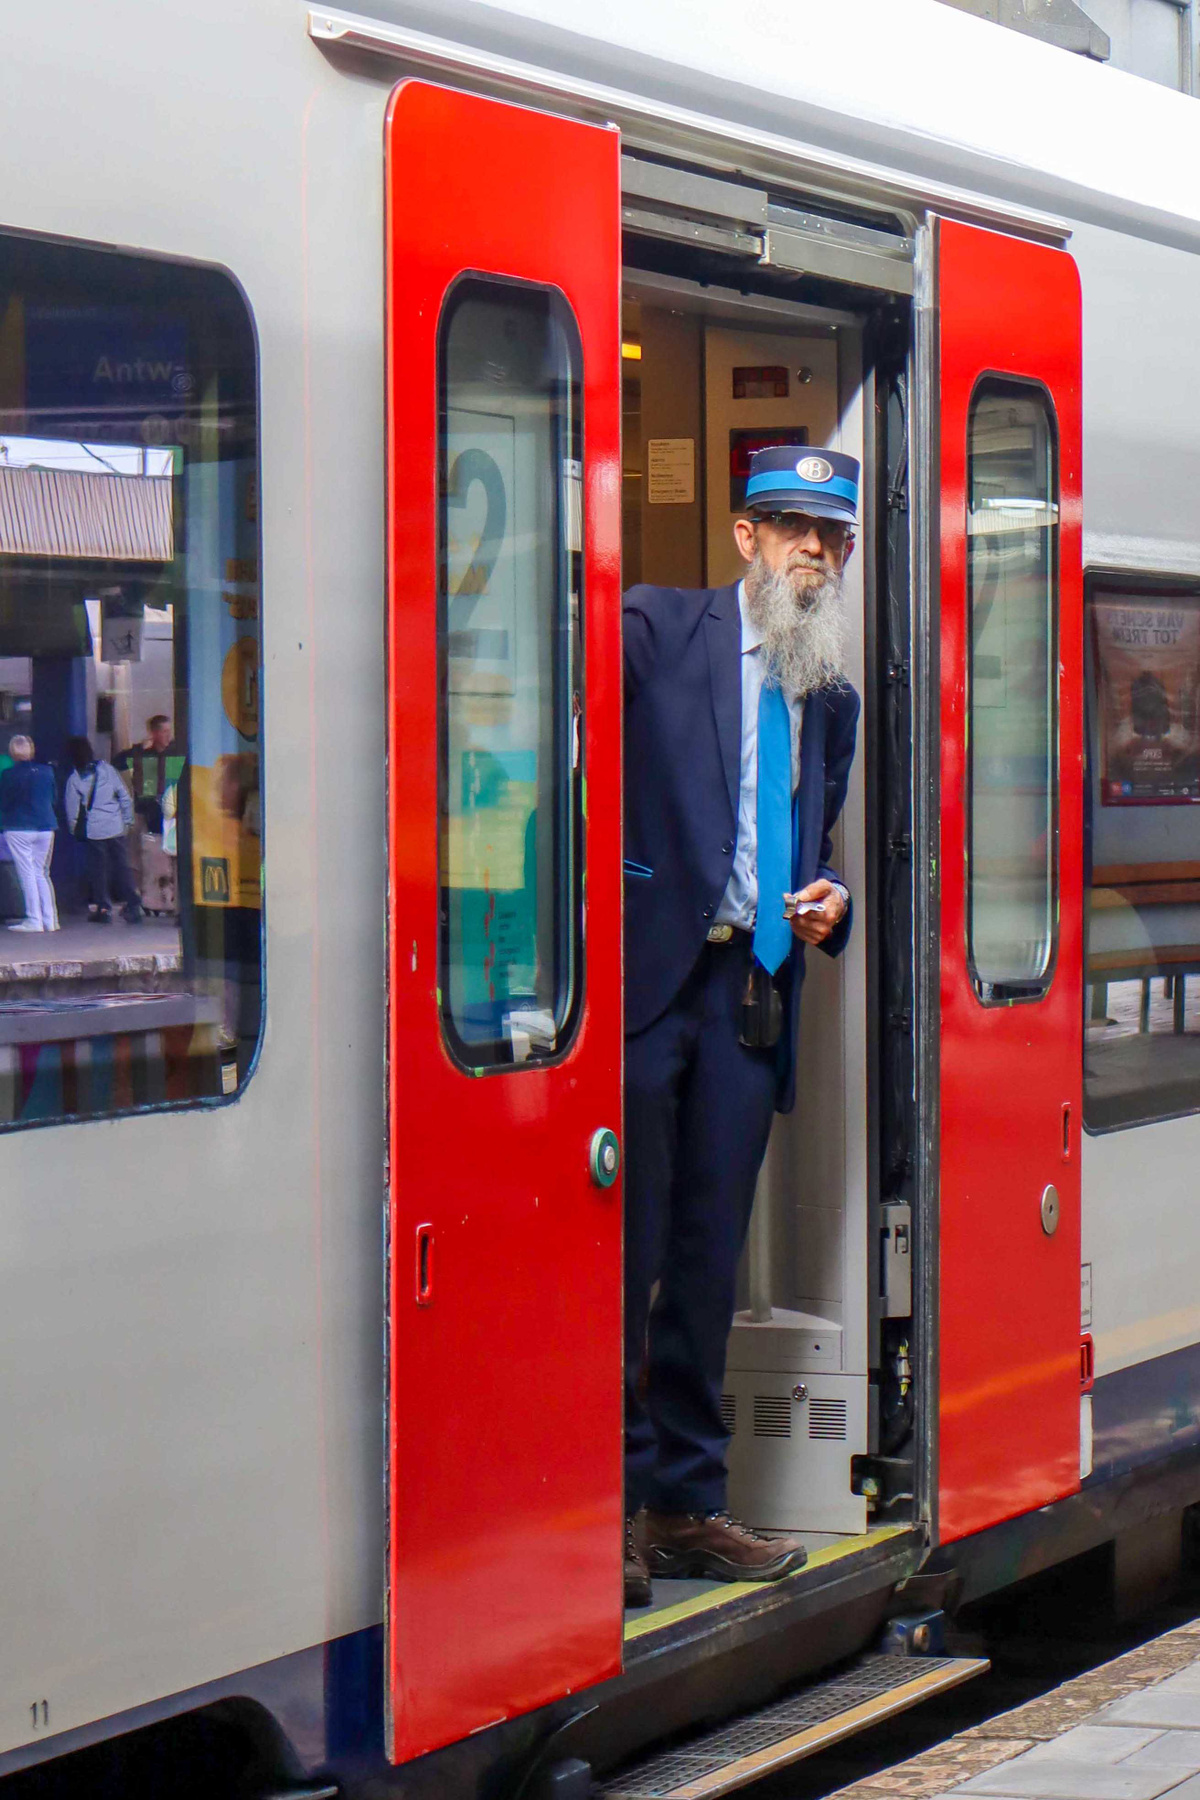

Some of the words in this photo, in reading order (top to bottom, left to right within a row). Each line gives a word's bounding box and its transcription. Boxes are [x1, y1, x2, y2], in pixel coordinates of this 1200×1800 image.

[807, 461, 821, 478] B
[447, 448, 509, 658] 2
[30, 1699, 48, 1729] 11
